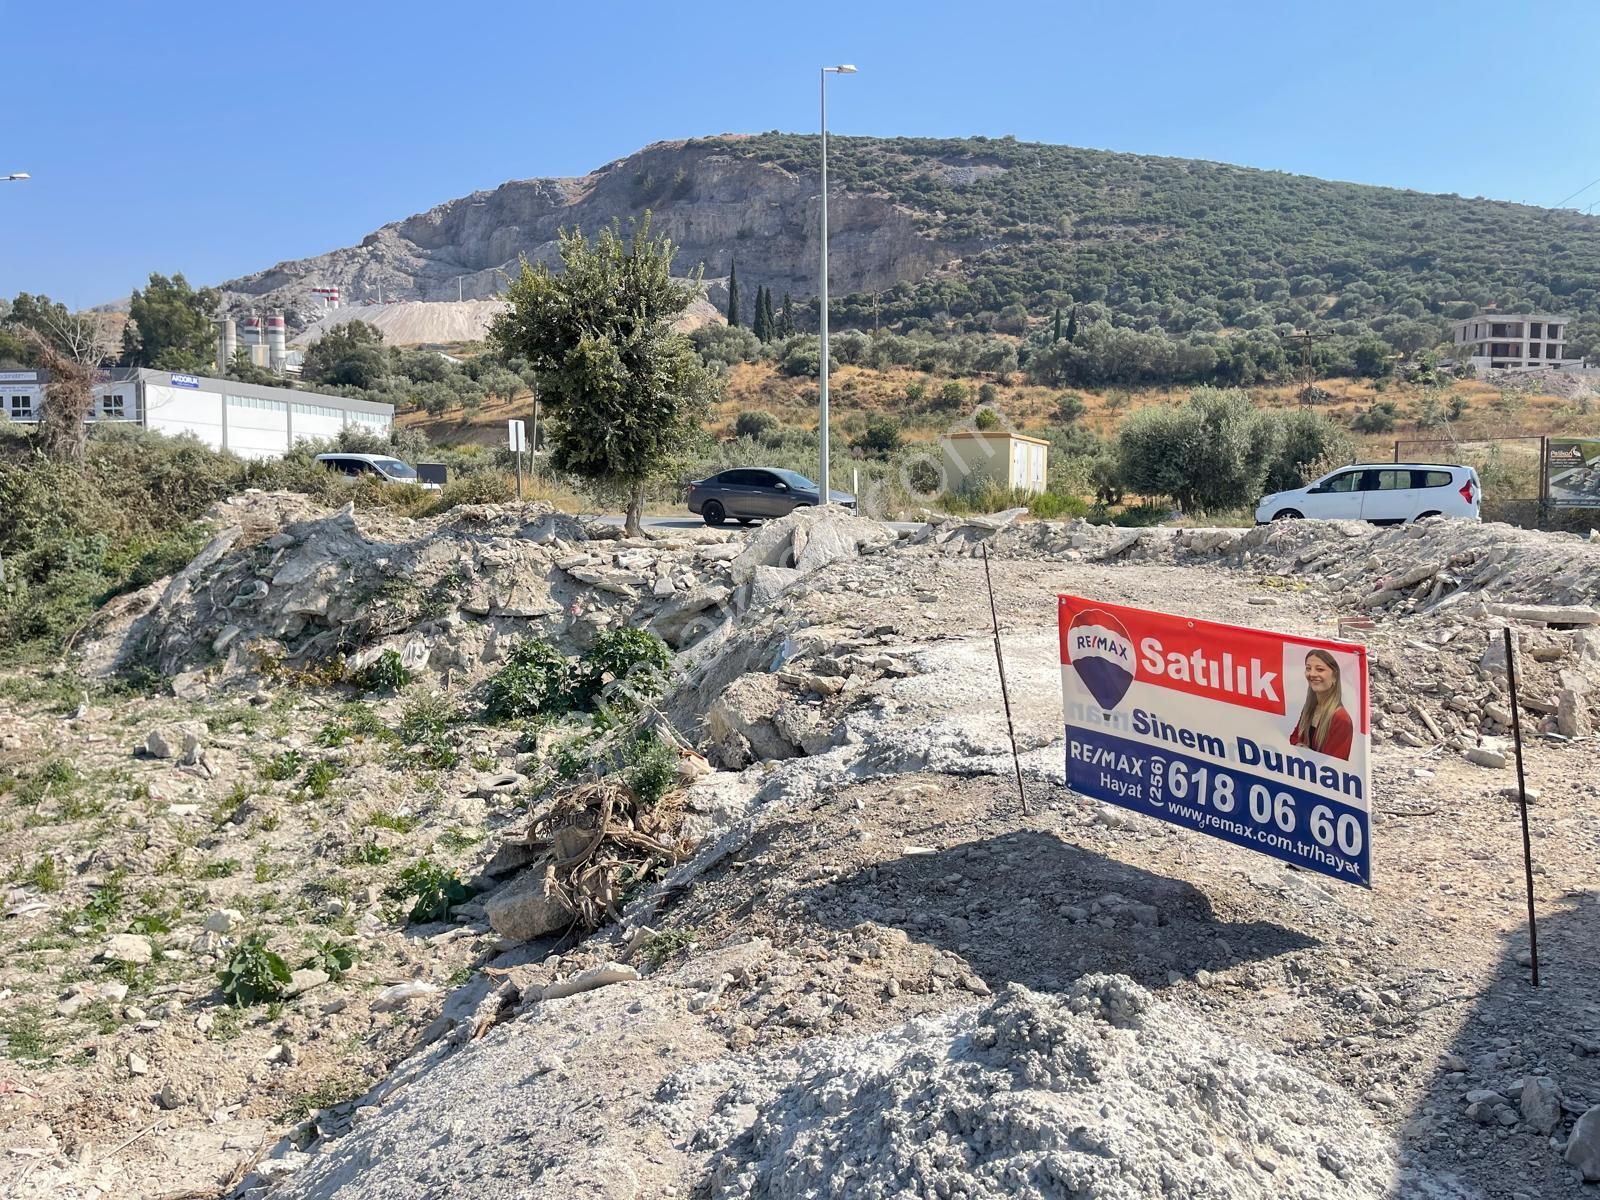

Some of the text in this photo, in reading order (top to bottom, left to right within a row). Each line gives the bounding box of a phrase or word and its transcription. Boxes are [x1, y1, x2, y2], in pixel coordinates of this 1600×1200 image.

[1077, 635, 1127, 660] RE/MAX
[1141, 637, 1280, 702] Satılık
[1071, 741, 1144, 777] RE/MAX
[1101, 772, 1142, 798] Hayat
[1133, 708, 1362, 799] Sinem Duman
[1149, 756, 1362, 857] (256) 618 06 60
[1168, 802, 1360, 874] www.remax.com.tr/hayat
